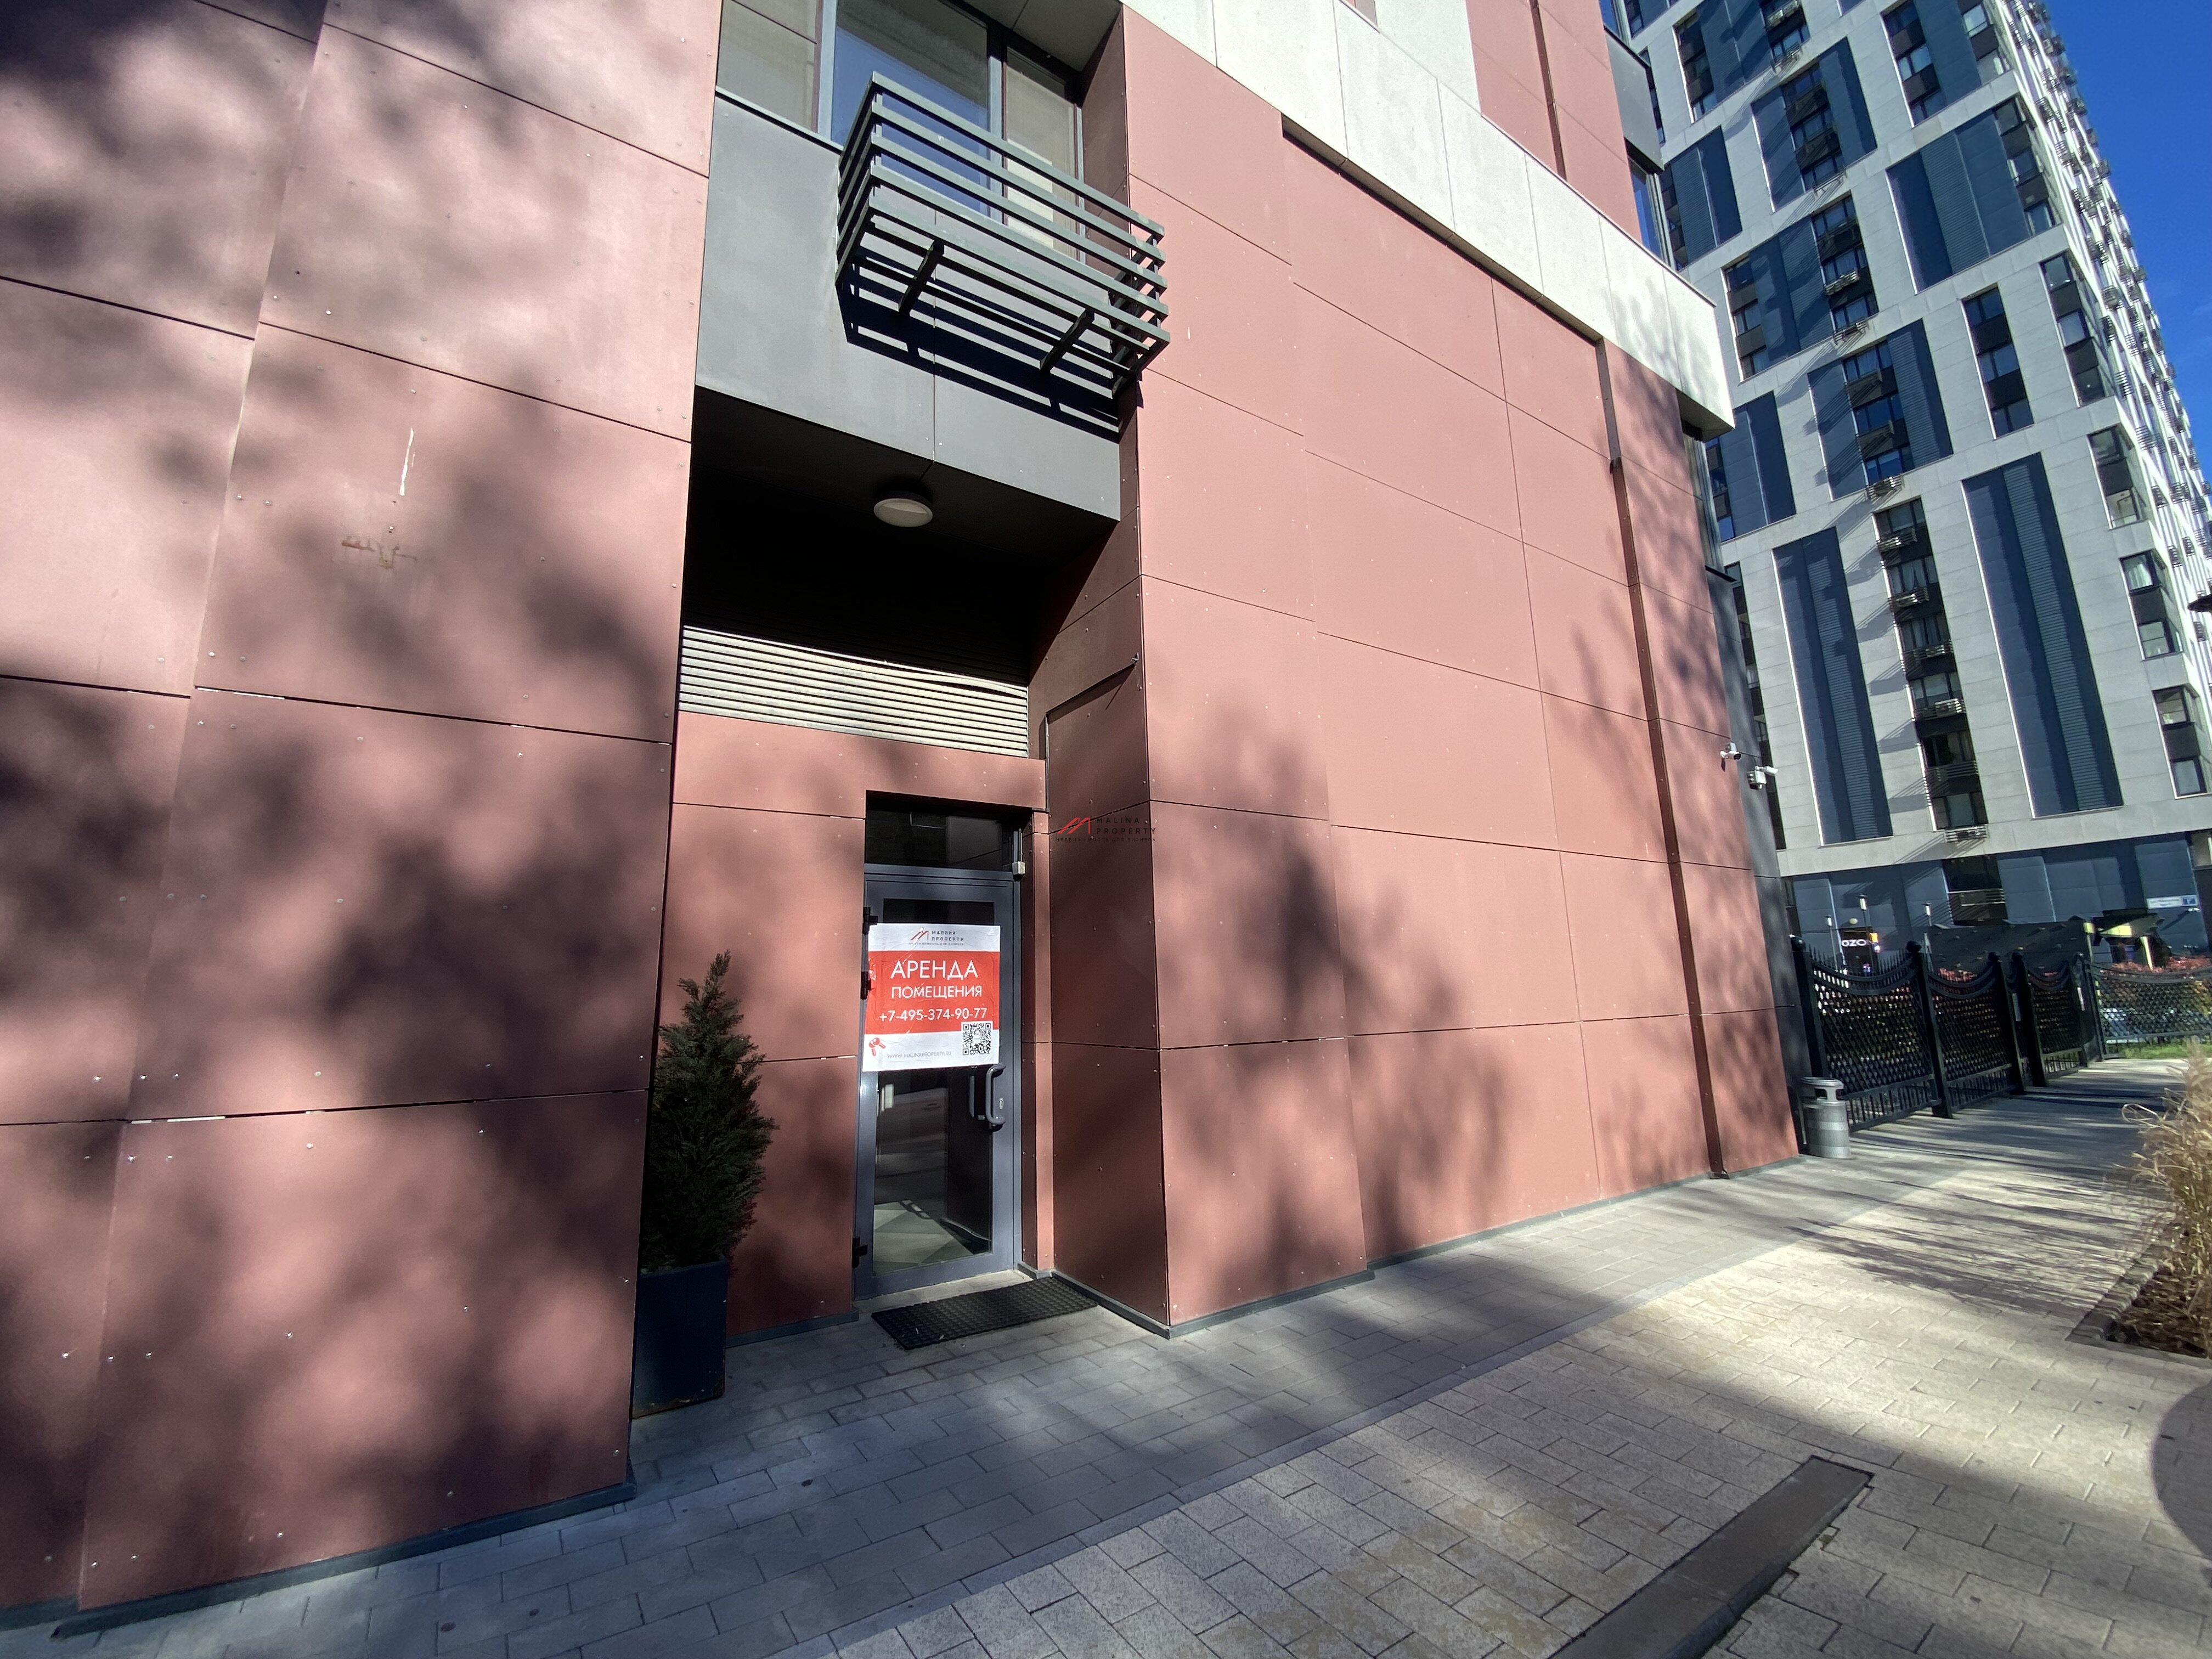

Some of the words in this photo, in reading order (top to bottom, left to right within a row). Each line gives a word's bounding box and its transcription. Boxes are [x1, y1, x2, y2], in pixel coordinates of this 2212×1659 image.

[890, 960, 978, 981] АРЕНДА
[891, 985, 982, 999] ПОМЕЩЕНИЯ
[879, 1007, 988, 1022] +7-495-374-90-77
